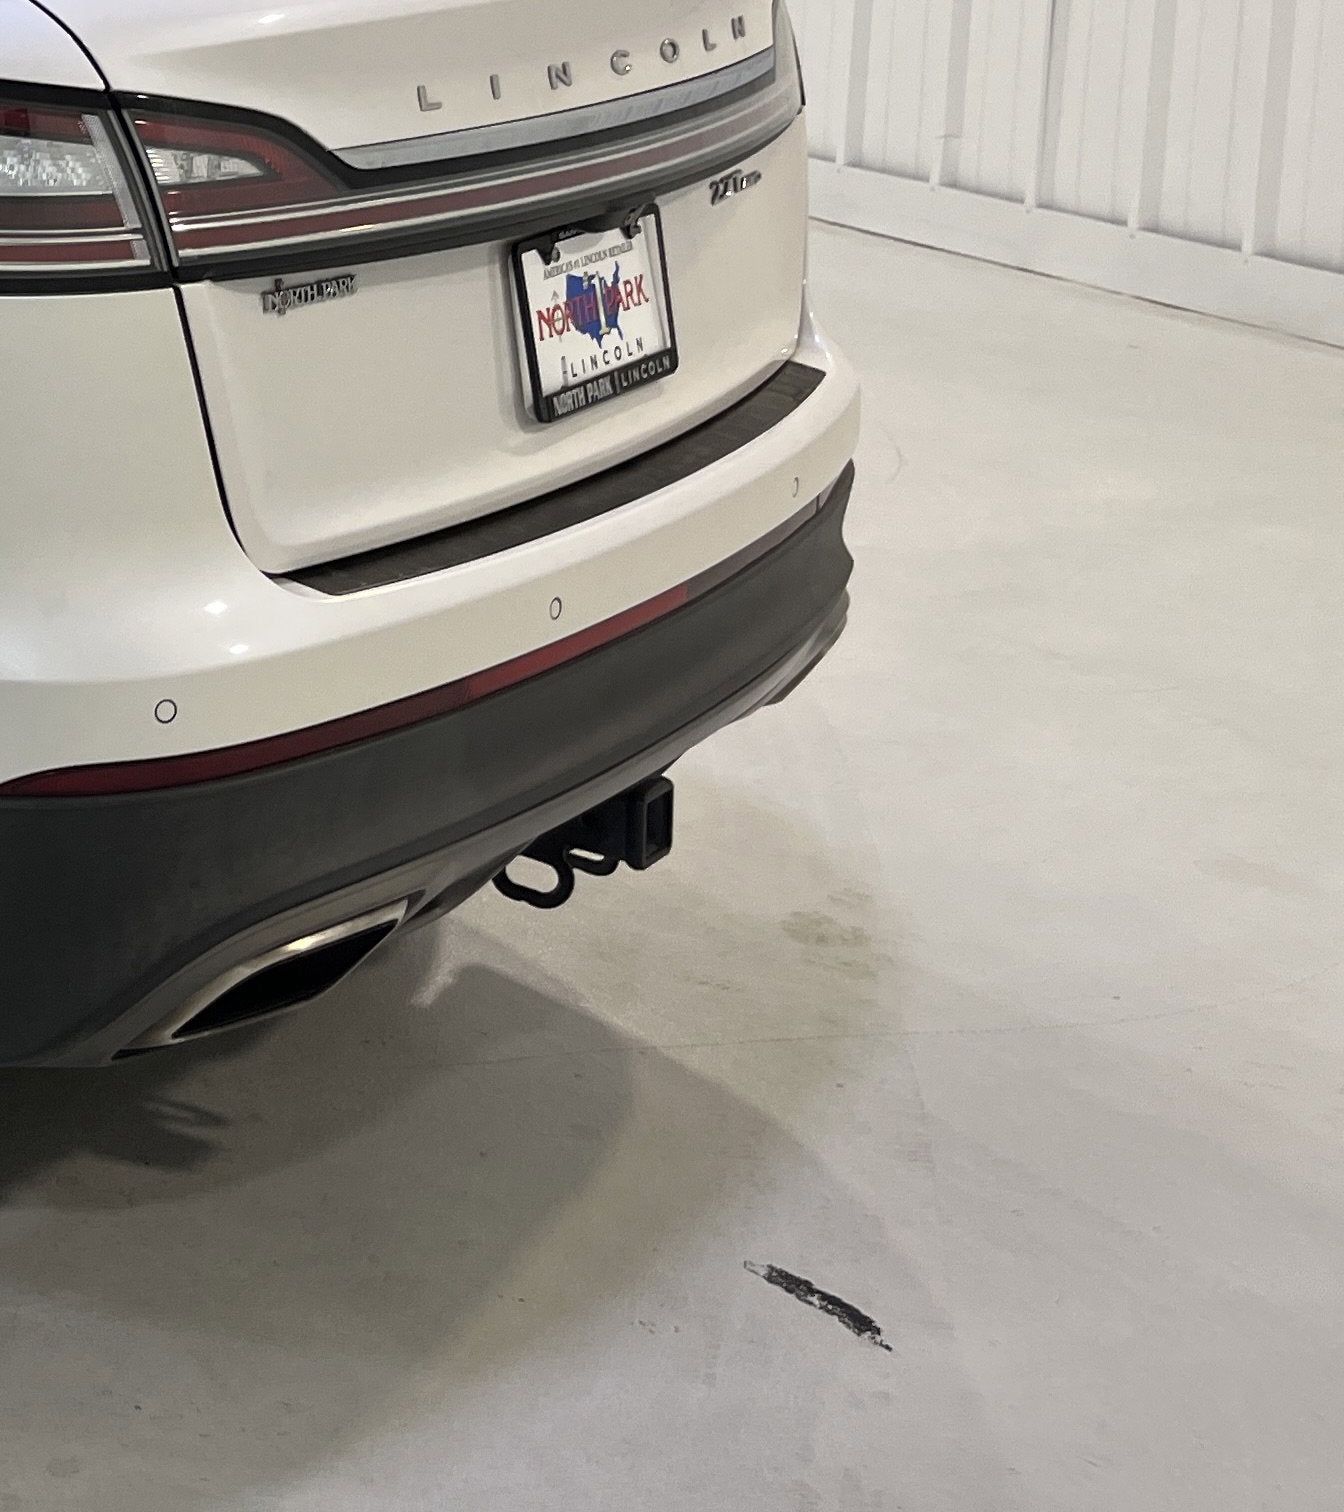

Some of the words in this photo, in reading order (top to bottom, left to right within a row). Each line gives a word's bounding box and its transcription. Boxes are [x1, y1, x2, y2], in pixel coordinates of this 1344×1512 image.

[417, 15, 746, 112] LINCOLN
[263, 279, 318, 316] NORTH
[321, 274, 358, 301] PARK
[536, 291, 600, 342] NORTH
[603, 274, 650, 316] PARK
[552, 386, 587, 417] NORTH
[587, 375, 614, 404] PARK
[620, 354, 671, 387] LINCOLN
[570, 336, 644, 378] LINCOLN
